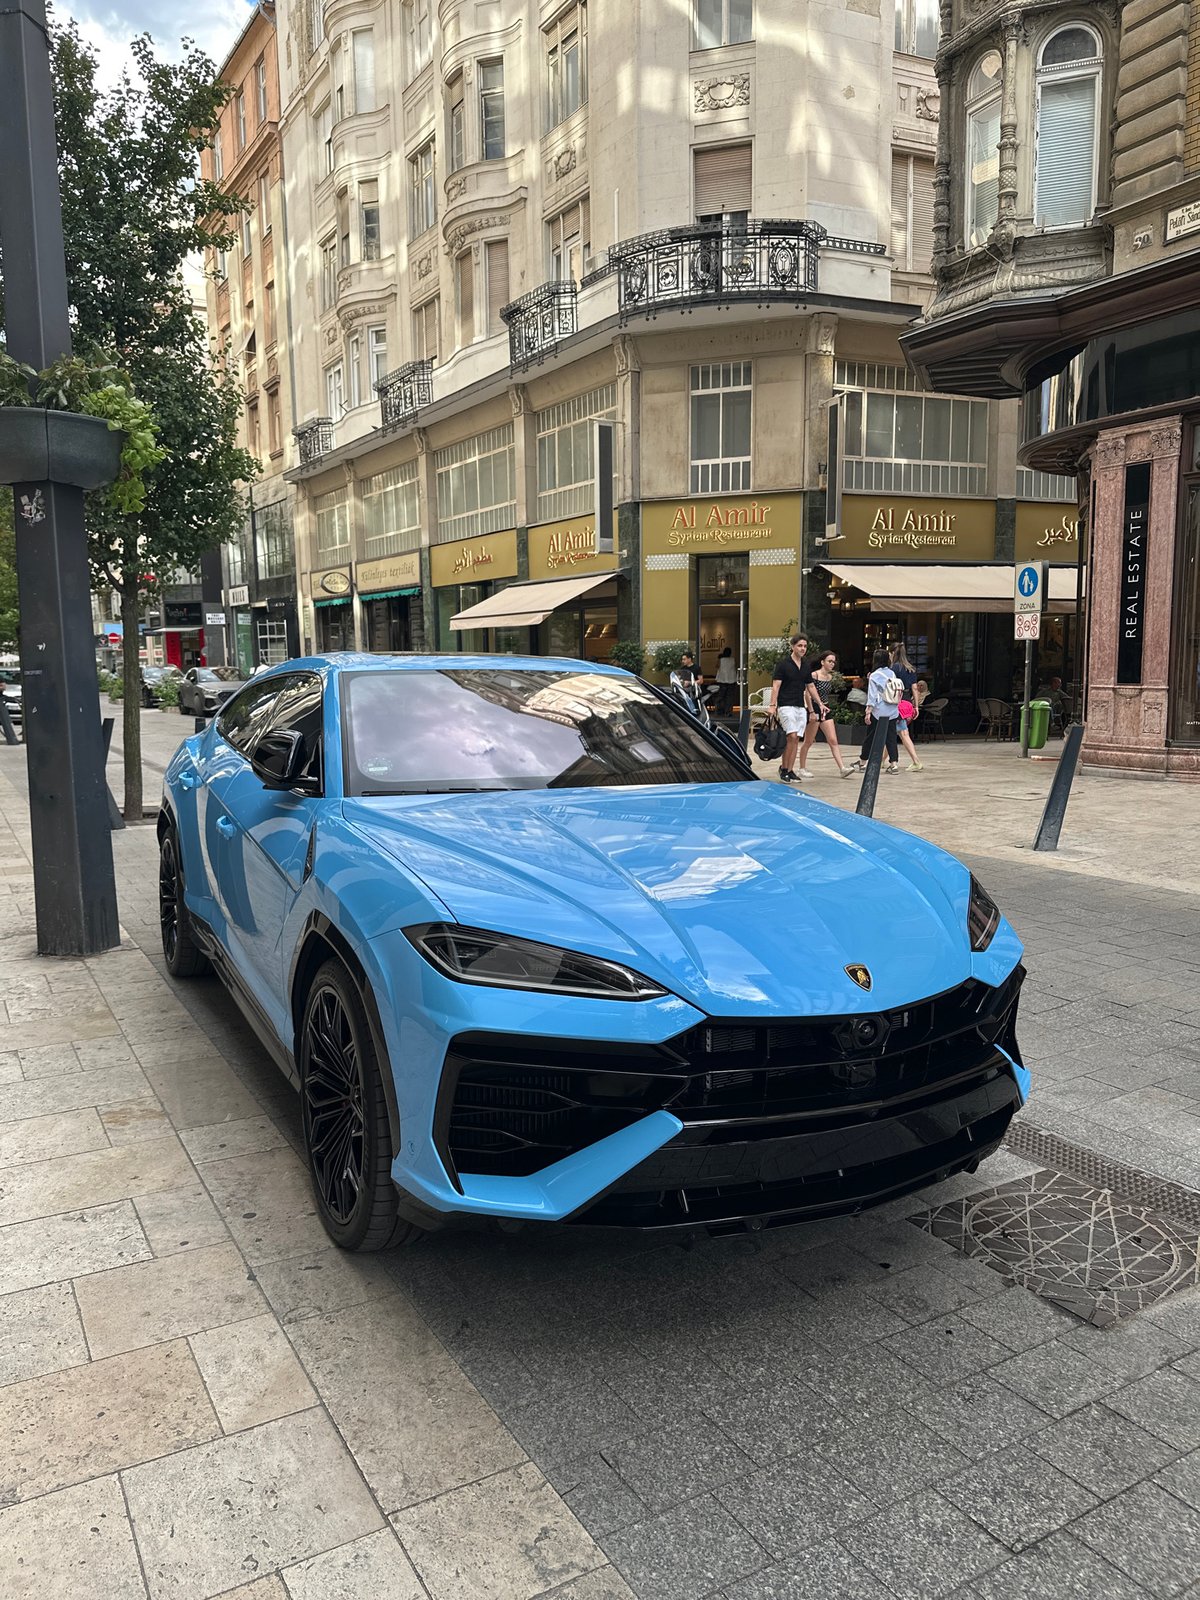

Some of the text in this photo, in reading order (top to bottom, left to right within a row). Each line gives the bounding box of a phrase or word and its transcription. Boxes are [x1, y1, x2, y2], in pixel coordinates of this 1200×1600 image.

[671, 501, 771, 529] Al Amir
[871, 507, 957, 532] Al Amir
[548, 525, 596, 553] Al Amir
[668, 528, 772, 546] Syrian Restaurant
[868, 531, 957, 549] Syrian Restaurant
[1125, 509, 1142, 638] REAL ESTATE
[1020, 602, 1036, 610] ZONA
